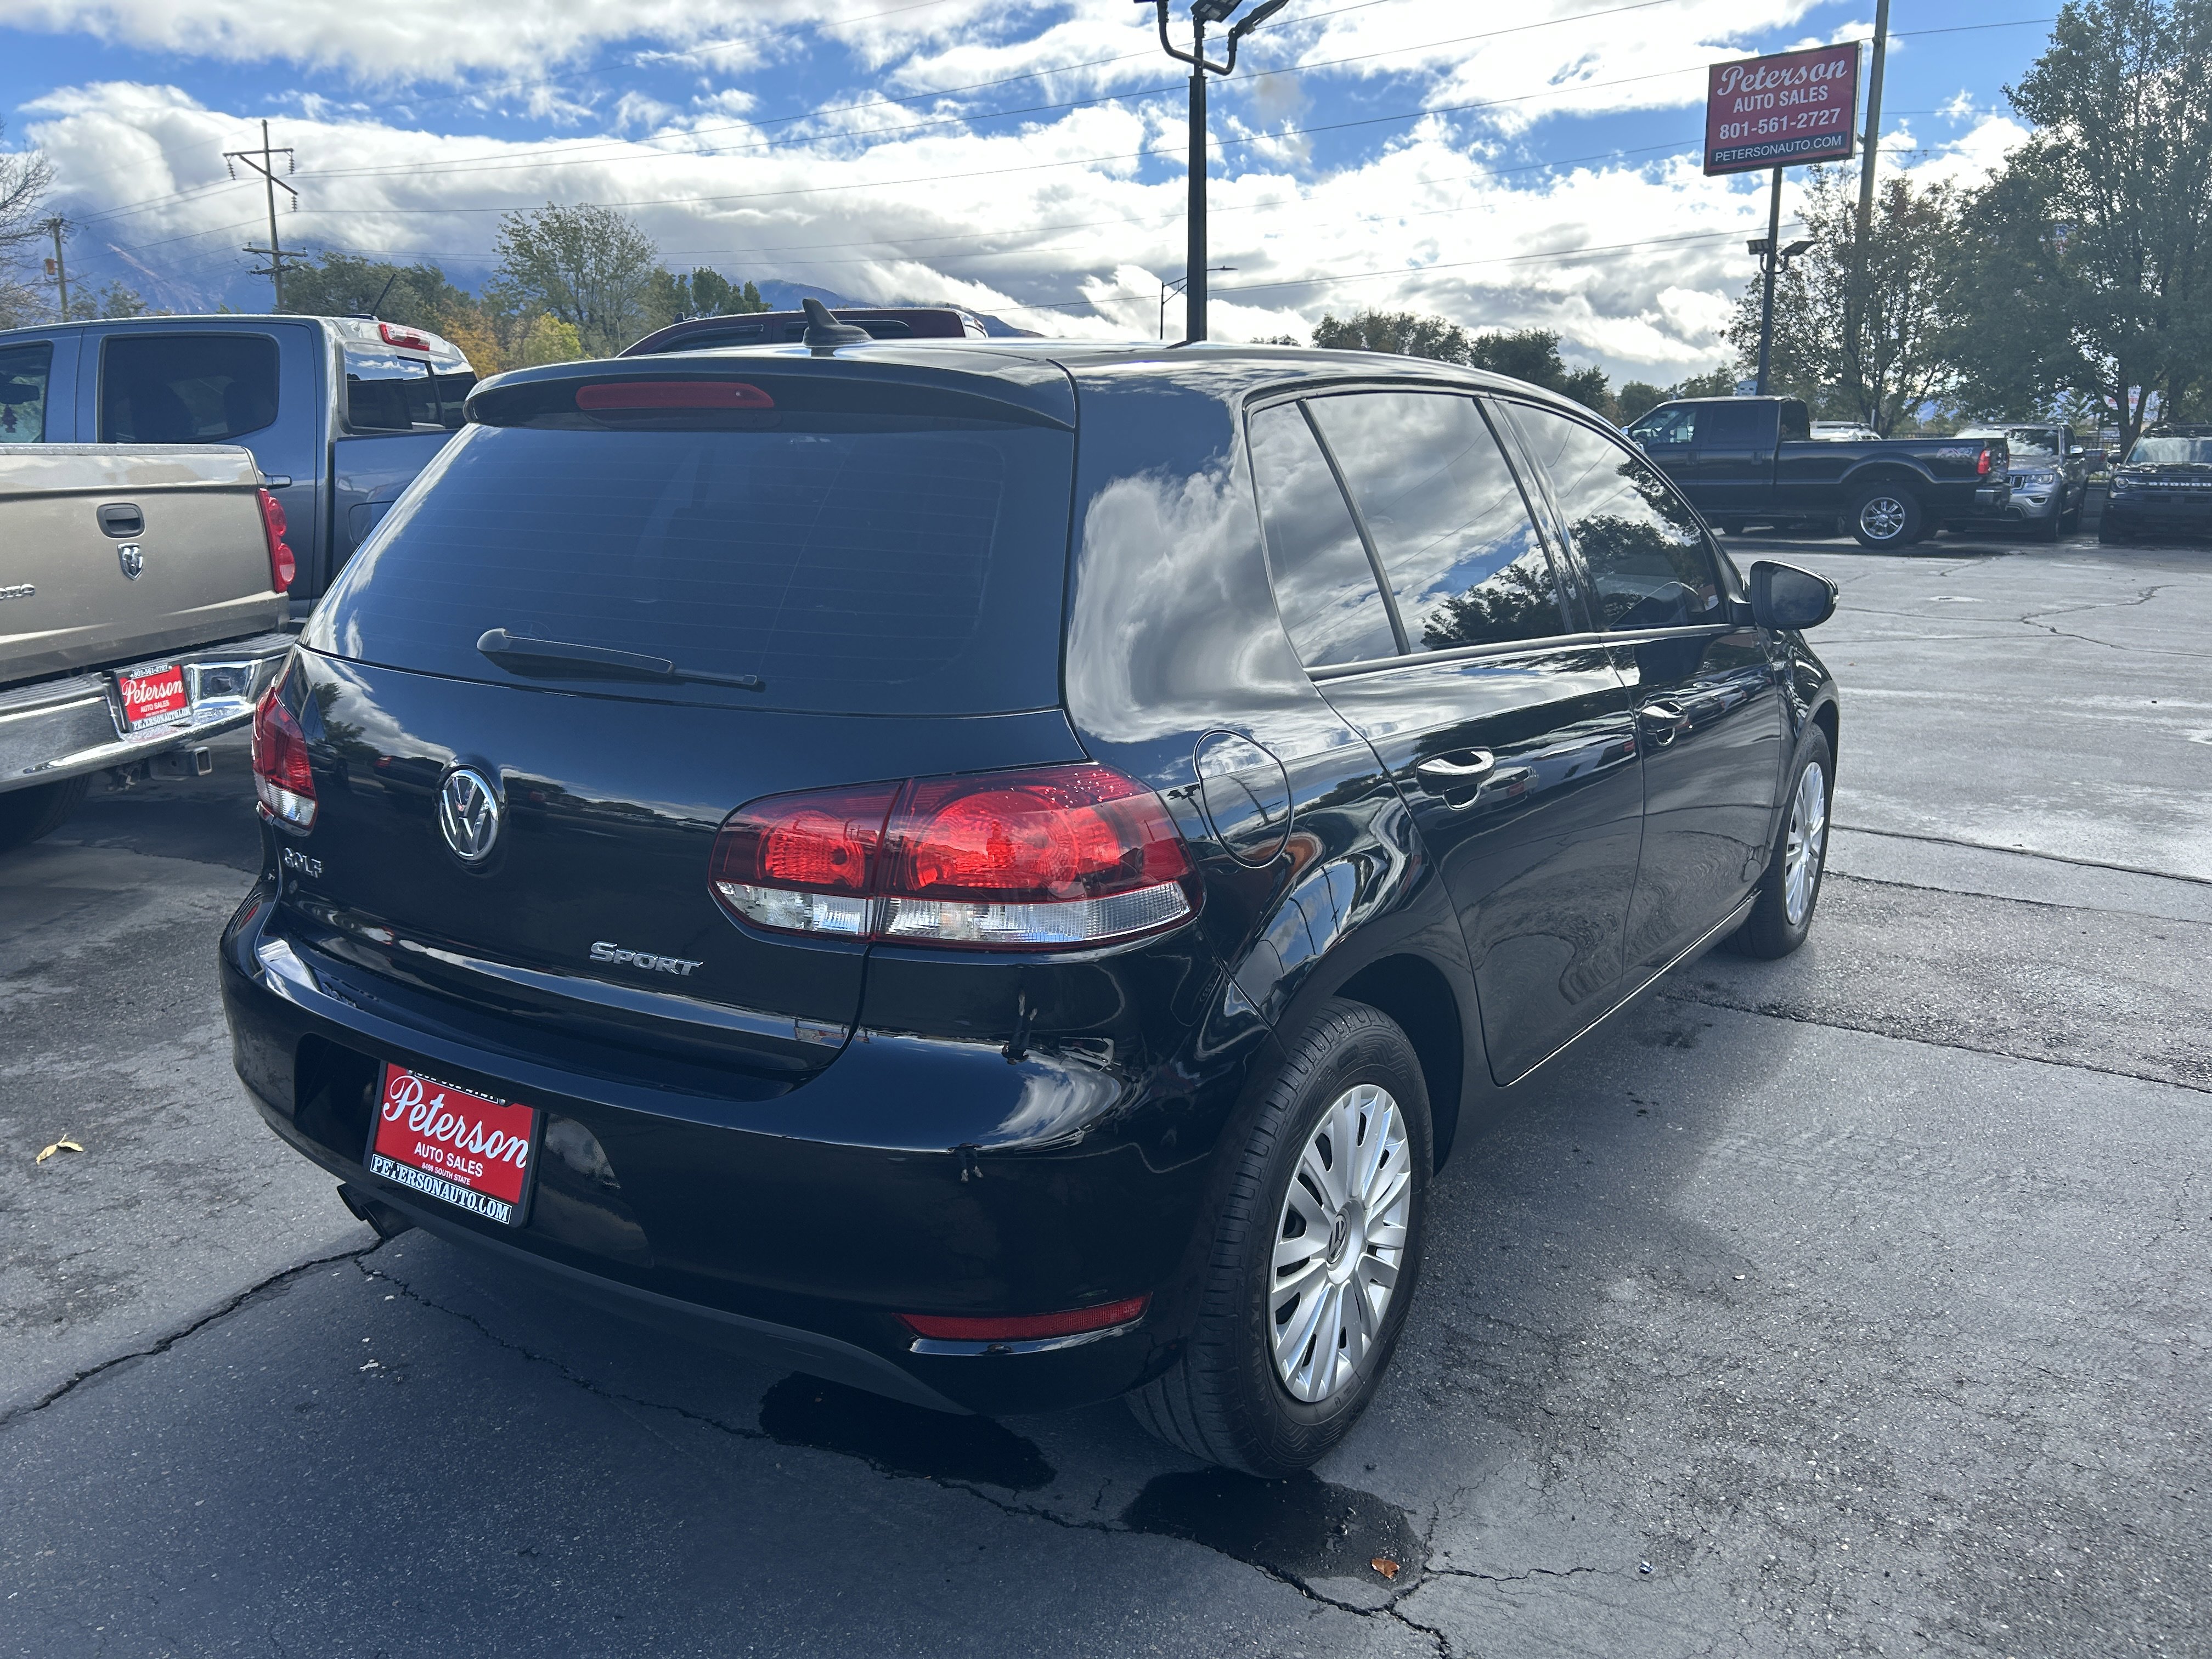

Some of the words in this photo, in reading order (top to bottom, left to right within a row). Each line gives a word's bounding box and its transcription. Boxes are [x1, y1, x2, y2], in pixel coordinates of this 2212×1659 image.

[1717, 60, 1848, 95] Peterson
[1733, 93, 1774, 113] AUTO
[1779, 85, 1828, 106] SALES
[1719, 108, 1841, 139] 801-561-2727
[1715, 135, 1842, 162] PETERSONAUTO.COM
[121, 680, 184, 707] Peterson
[140, 704, 154, 713] AUTO
[154, 699, 170, 710] SALES
[283, 847, 323, 878] GOLF
[589, 941, 704, 977] SPORT
[383, 1075, 529, 1169] Peterson
[414, 1142, 444, 1163] AUTO
[446, 1153, 483, 1177] SALES
[435, 1166, 453, 1179] SOUTH
[454, 1173, 471, 1186] STATE
